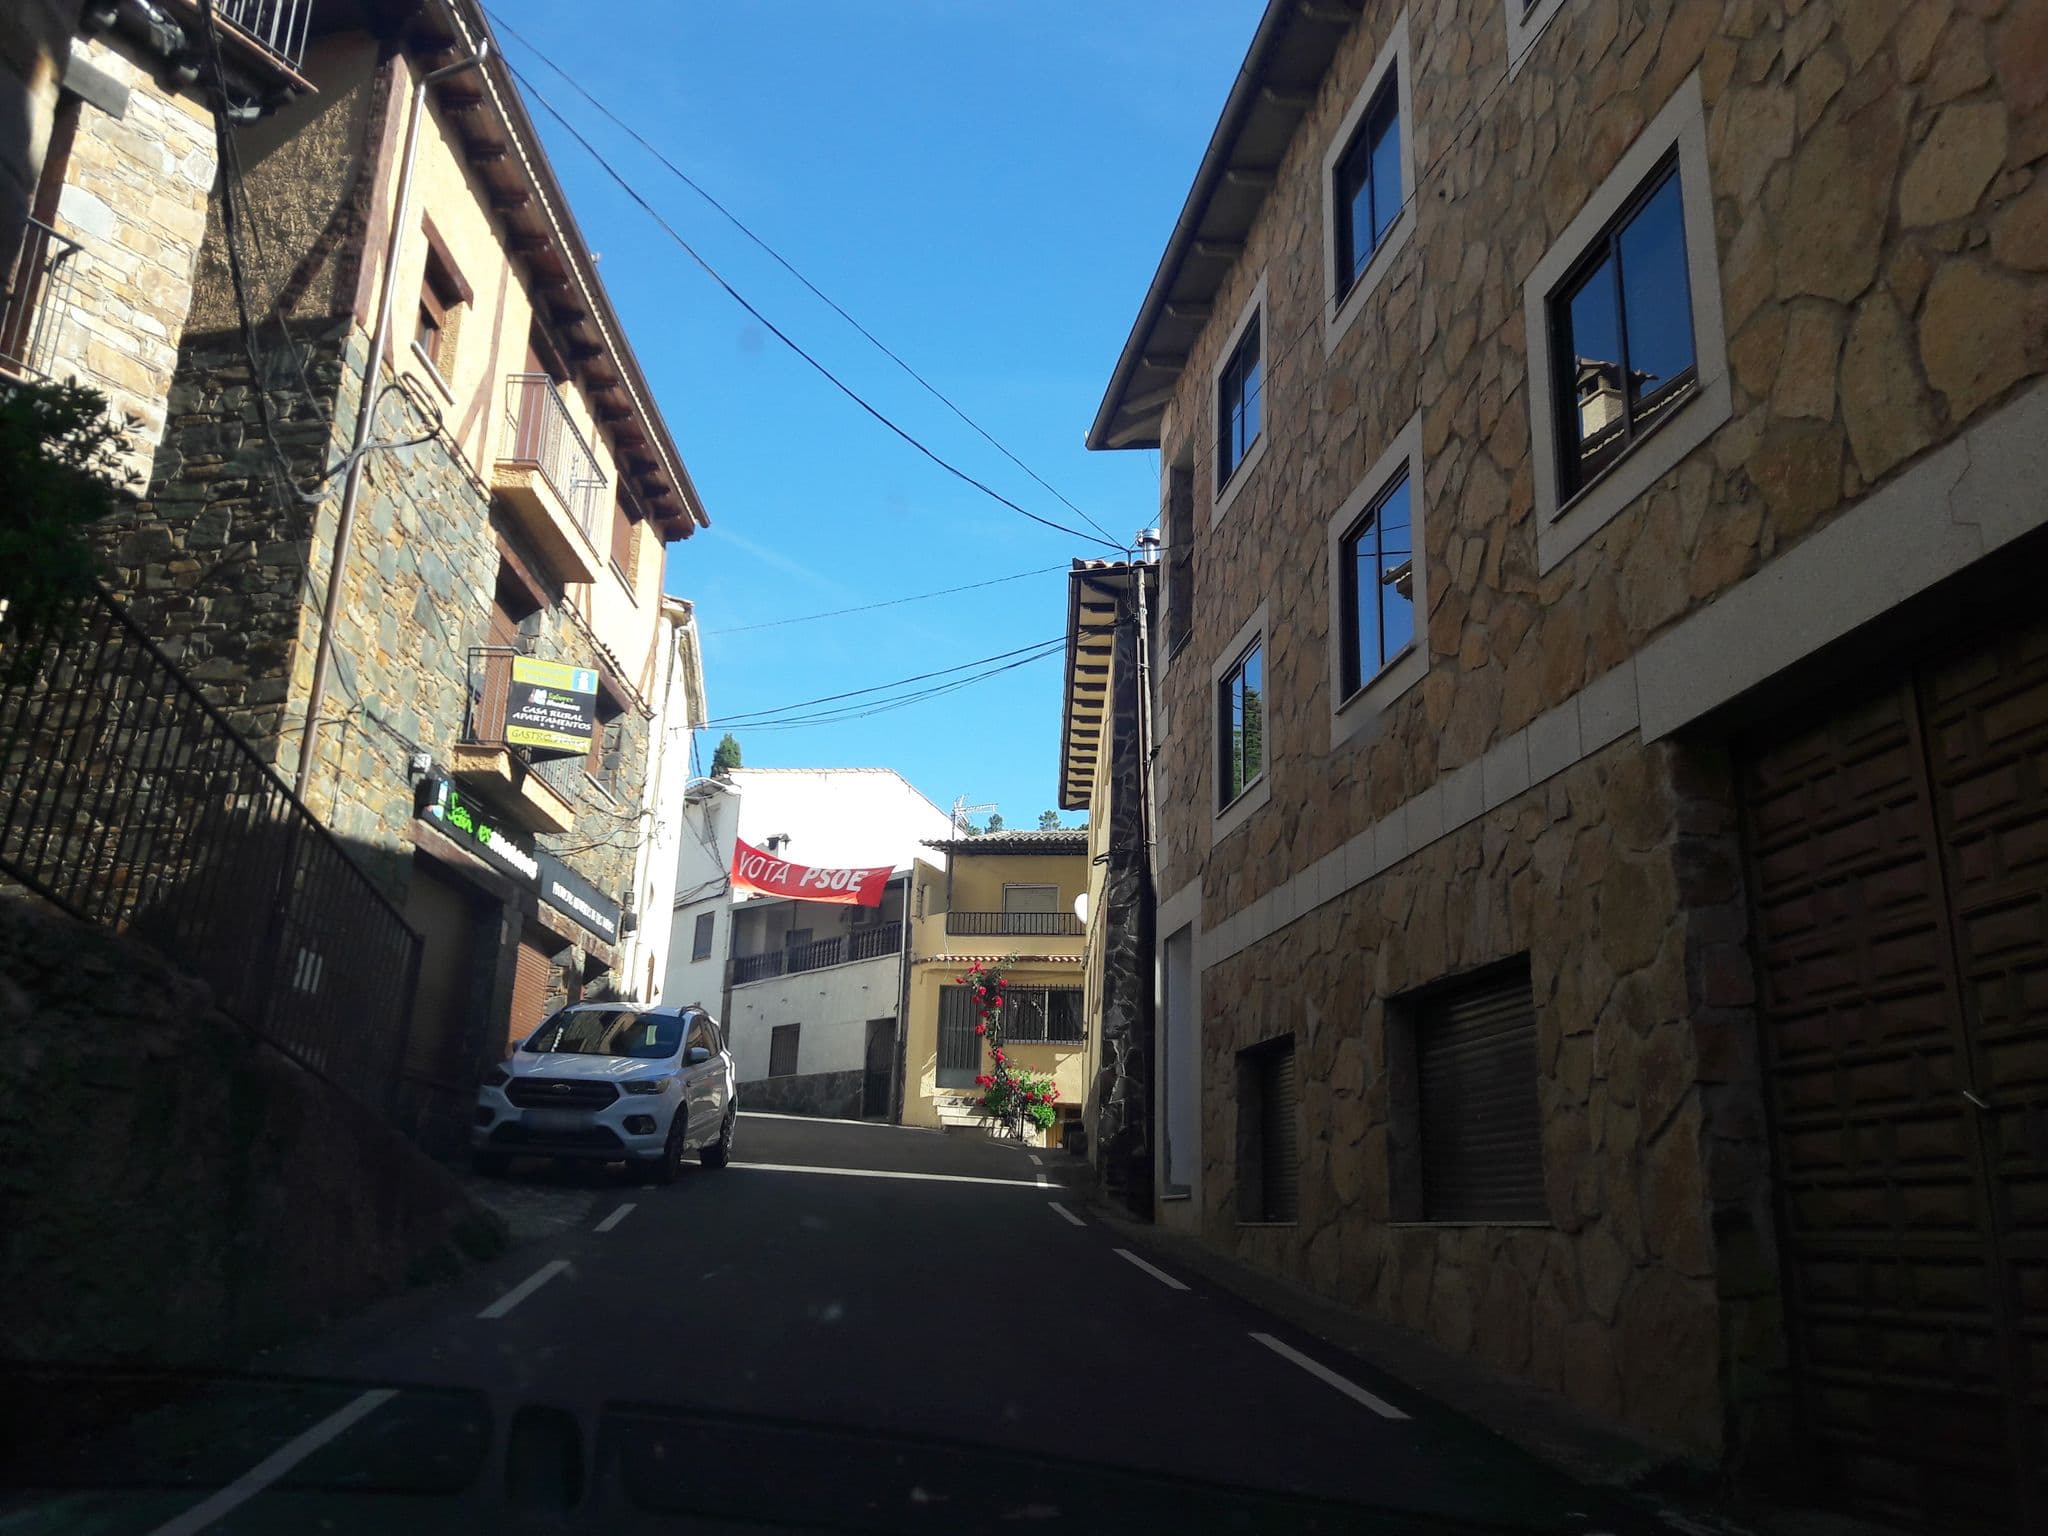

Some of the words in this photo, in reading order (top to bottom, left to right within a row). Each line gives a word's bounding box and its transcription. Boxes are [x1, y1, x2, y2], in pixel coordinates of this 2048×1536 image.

[512, 712, 591, 731] APARTAMENTOS
[522, 705, 548, 717] CASA
[549, 710, 583, 722] RURAL
[738, 851, 791, 884] VOTA
[800, 867, 868, 892] PSOE
